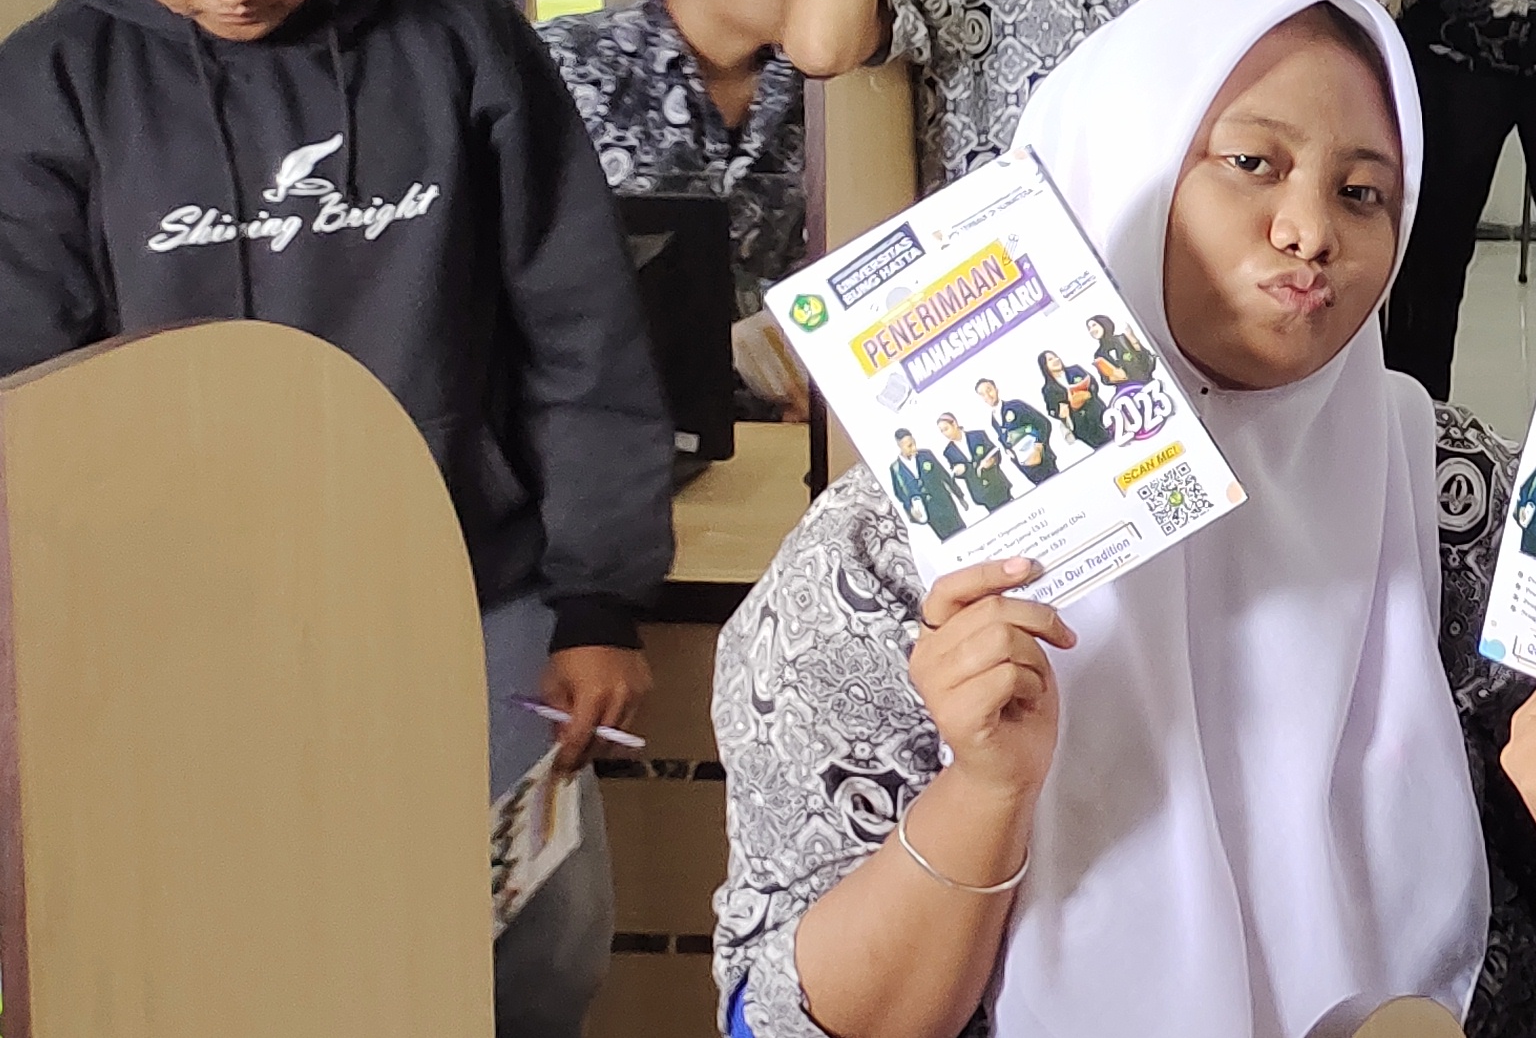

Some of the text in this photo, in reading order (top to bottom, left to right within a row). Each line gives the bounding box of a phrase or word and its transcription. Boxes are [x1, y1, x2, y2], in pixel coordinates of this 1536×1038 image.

[149, 182, 440, 252] Shining Bright
[880, 246, 923, 280] HATTA
[863, 255, 1006, 369] PENERIMAAN
[907, 275, 1045, 384] MAHASISWA BARU
[1103, 379, 1175, 447] 2023
[1123, 444, 1179, 485] SCAN ME!
[1064, 562, 1085, 583] Our
[1085, 537, 1131, 572] Tradition
